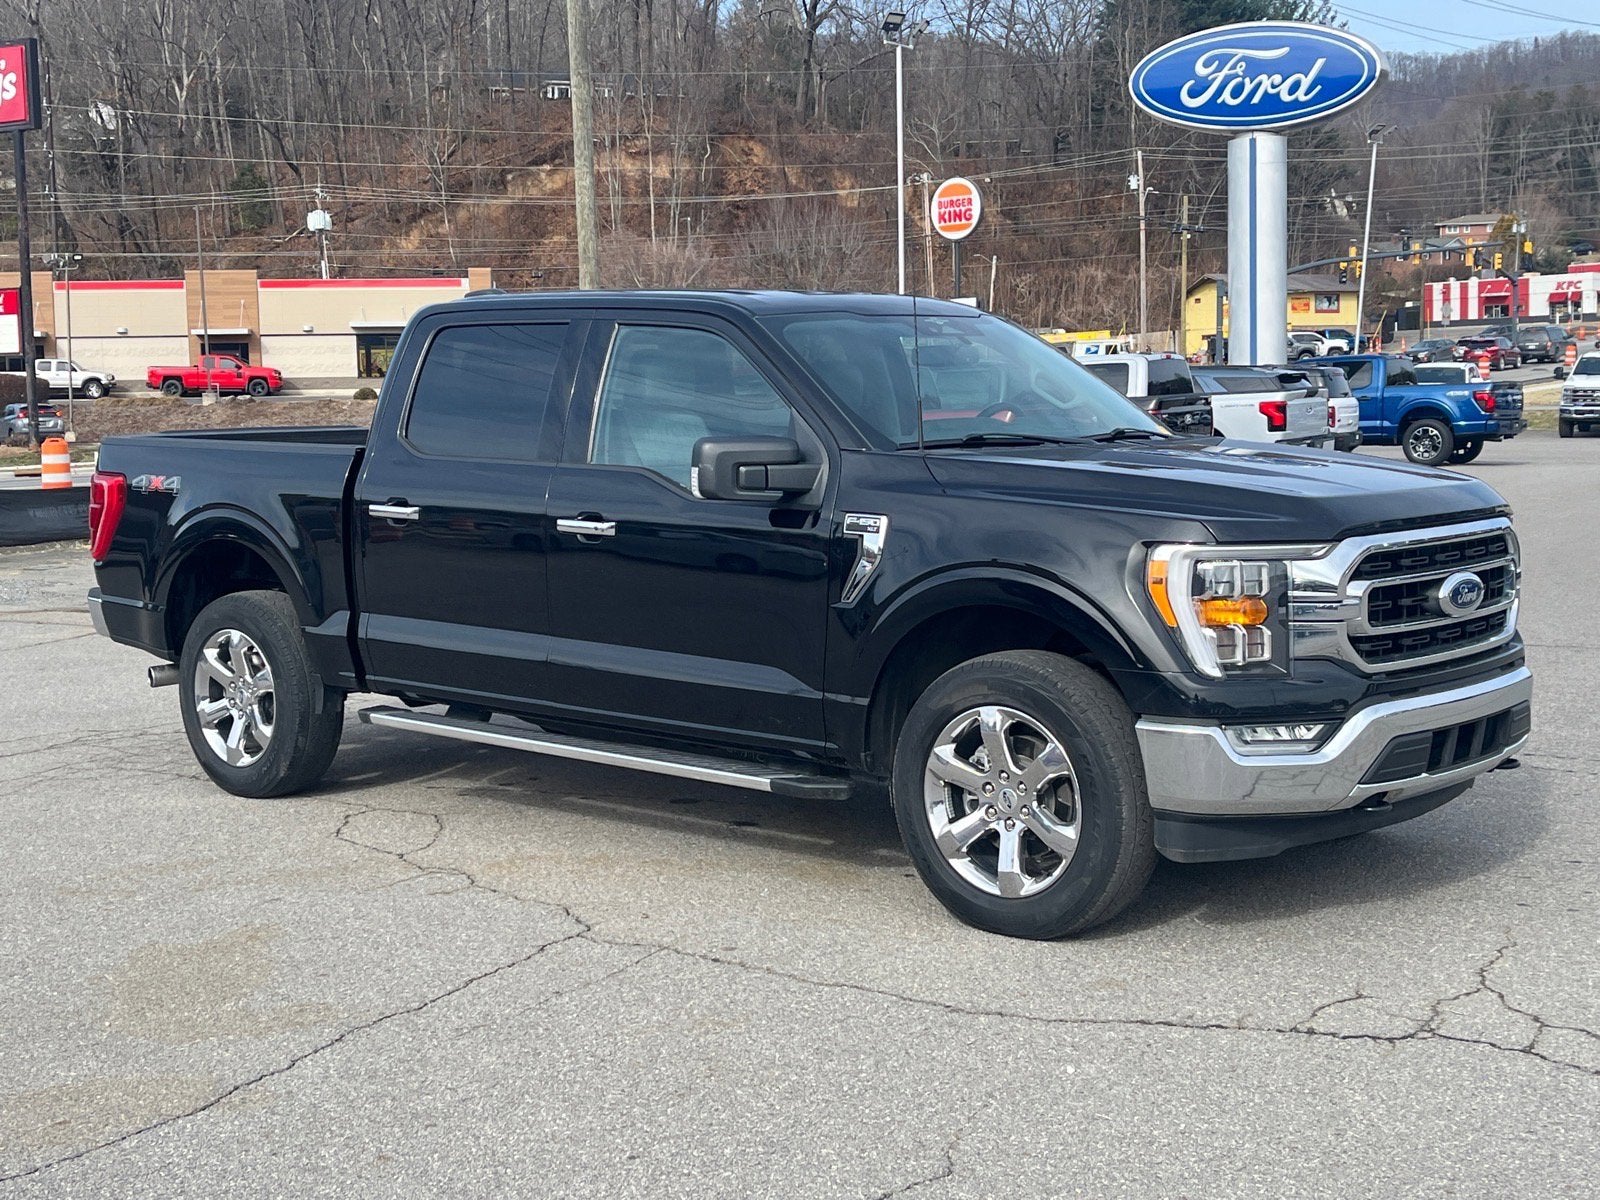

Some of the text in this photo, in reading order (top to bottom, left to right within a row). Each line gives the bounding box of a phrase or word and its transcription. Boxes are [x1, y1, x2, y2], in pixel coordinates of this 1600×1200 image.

[1180, 46, 1327, 108] Ford
[938, 198, 973, 210] BURGER
[938, 207, 973, 225] KING
[1555, 280, 1583, 291] KFC
[1457, 583, 1478, 604] Ford
